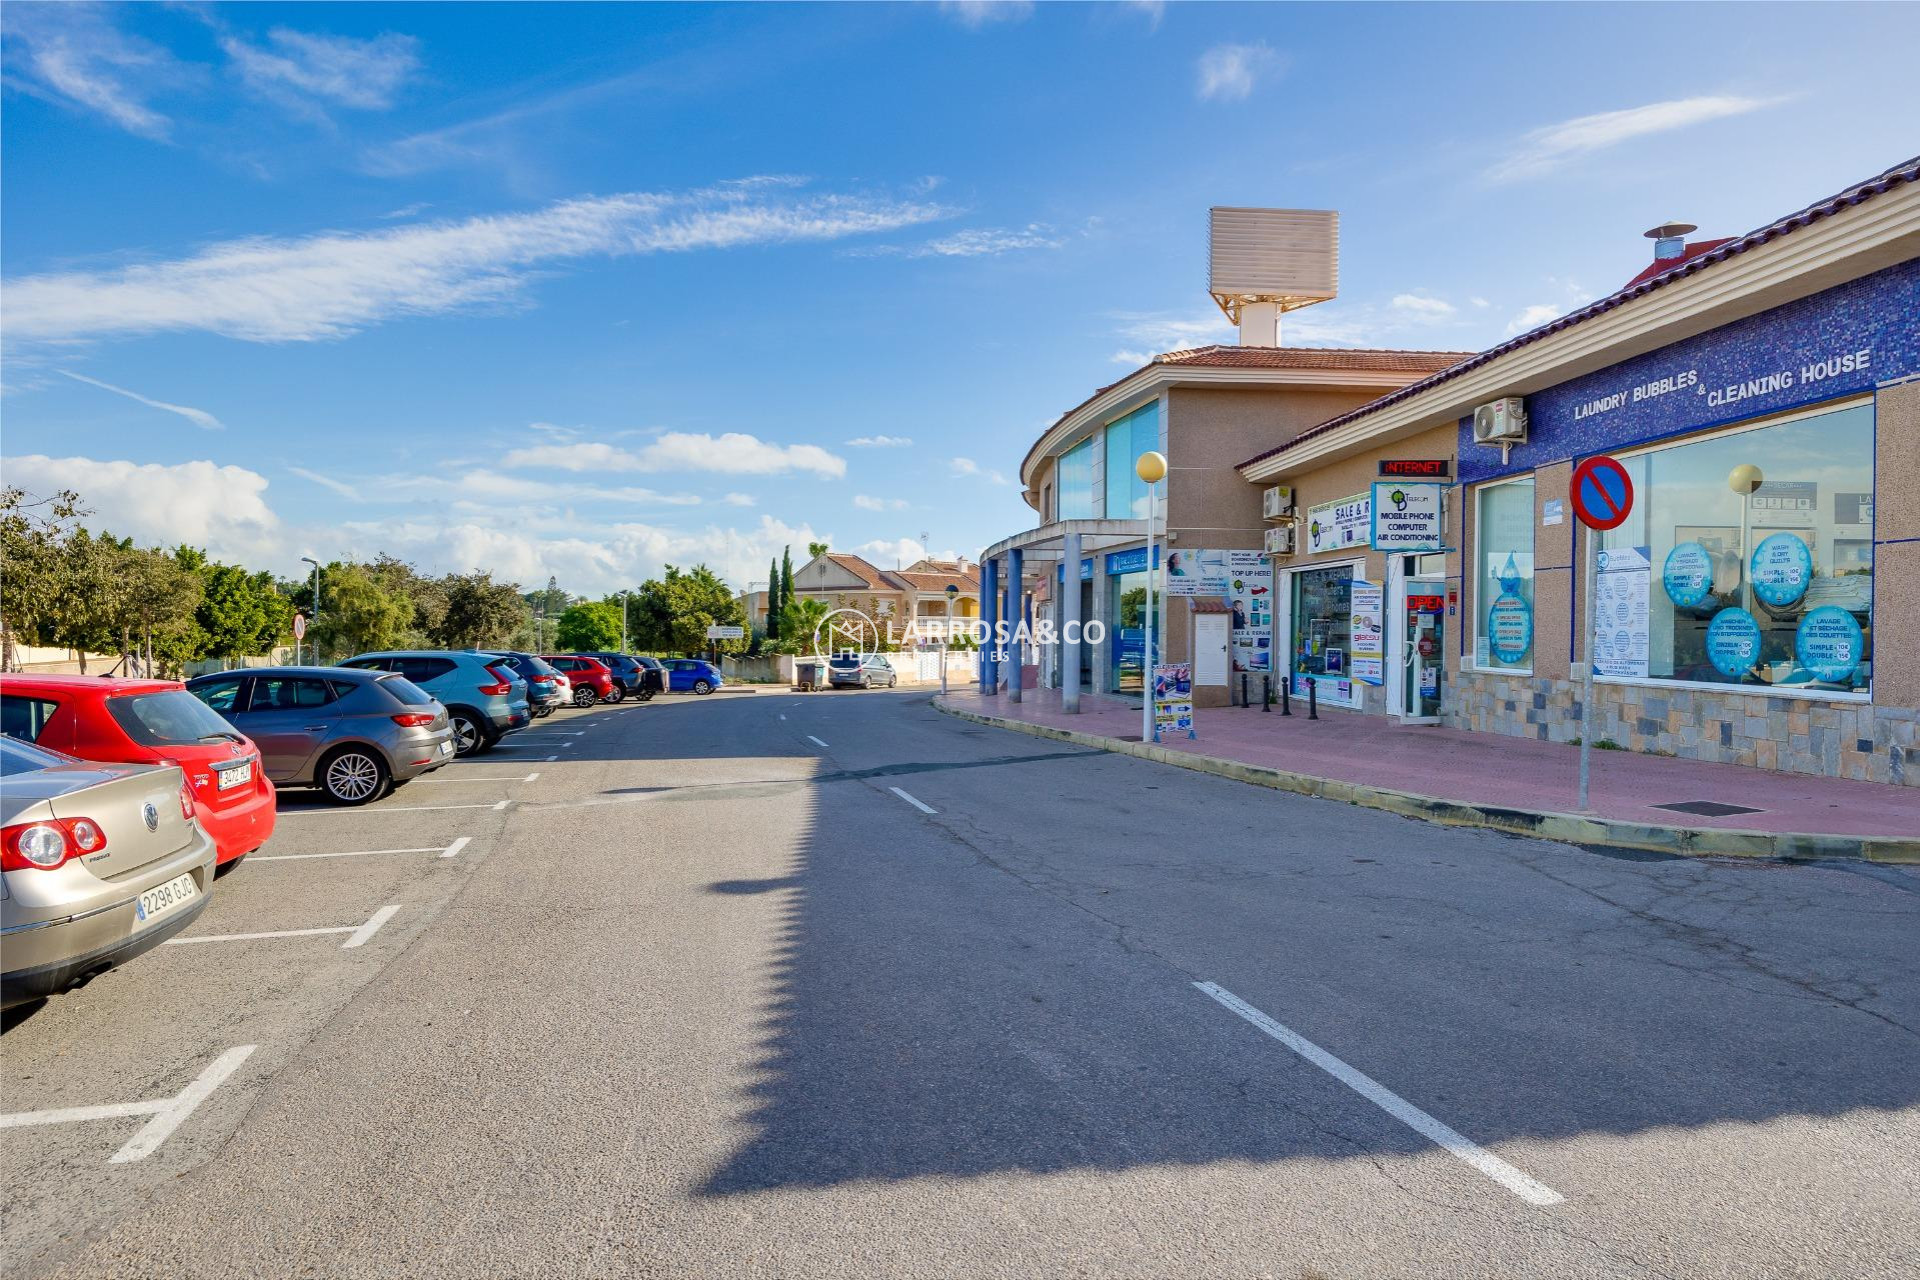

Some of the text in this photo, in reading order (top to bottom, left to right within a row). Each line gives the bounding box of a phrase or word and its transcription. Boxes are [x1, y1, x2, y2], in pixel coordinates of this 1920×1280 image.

[1574, 349, 1871, 420] LAUNDRY BUBBLES & CLEANING HOUSE
[1385, 461, 1442, 473] INTERNET
[1859, 495, 1873, 504] LA
[1335, 505, 1354, 520] SALE
[1356, 503, 1362, 516] &
[1381, 512, 1435, 520] MOBILE PHONE
[1387, 523, 1428, 531] COMPUTER
[1406, 595, 1445, 609] OPEN
[224, 768, 239, 784] 3472
[143, 877, 192, 915] 2298 GJC
